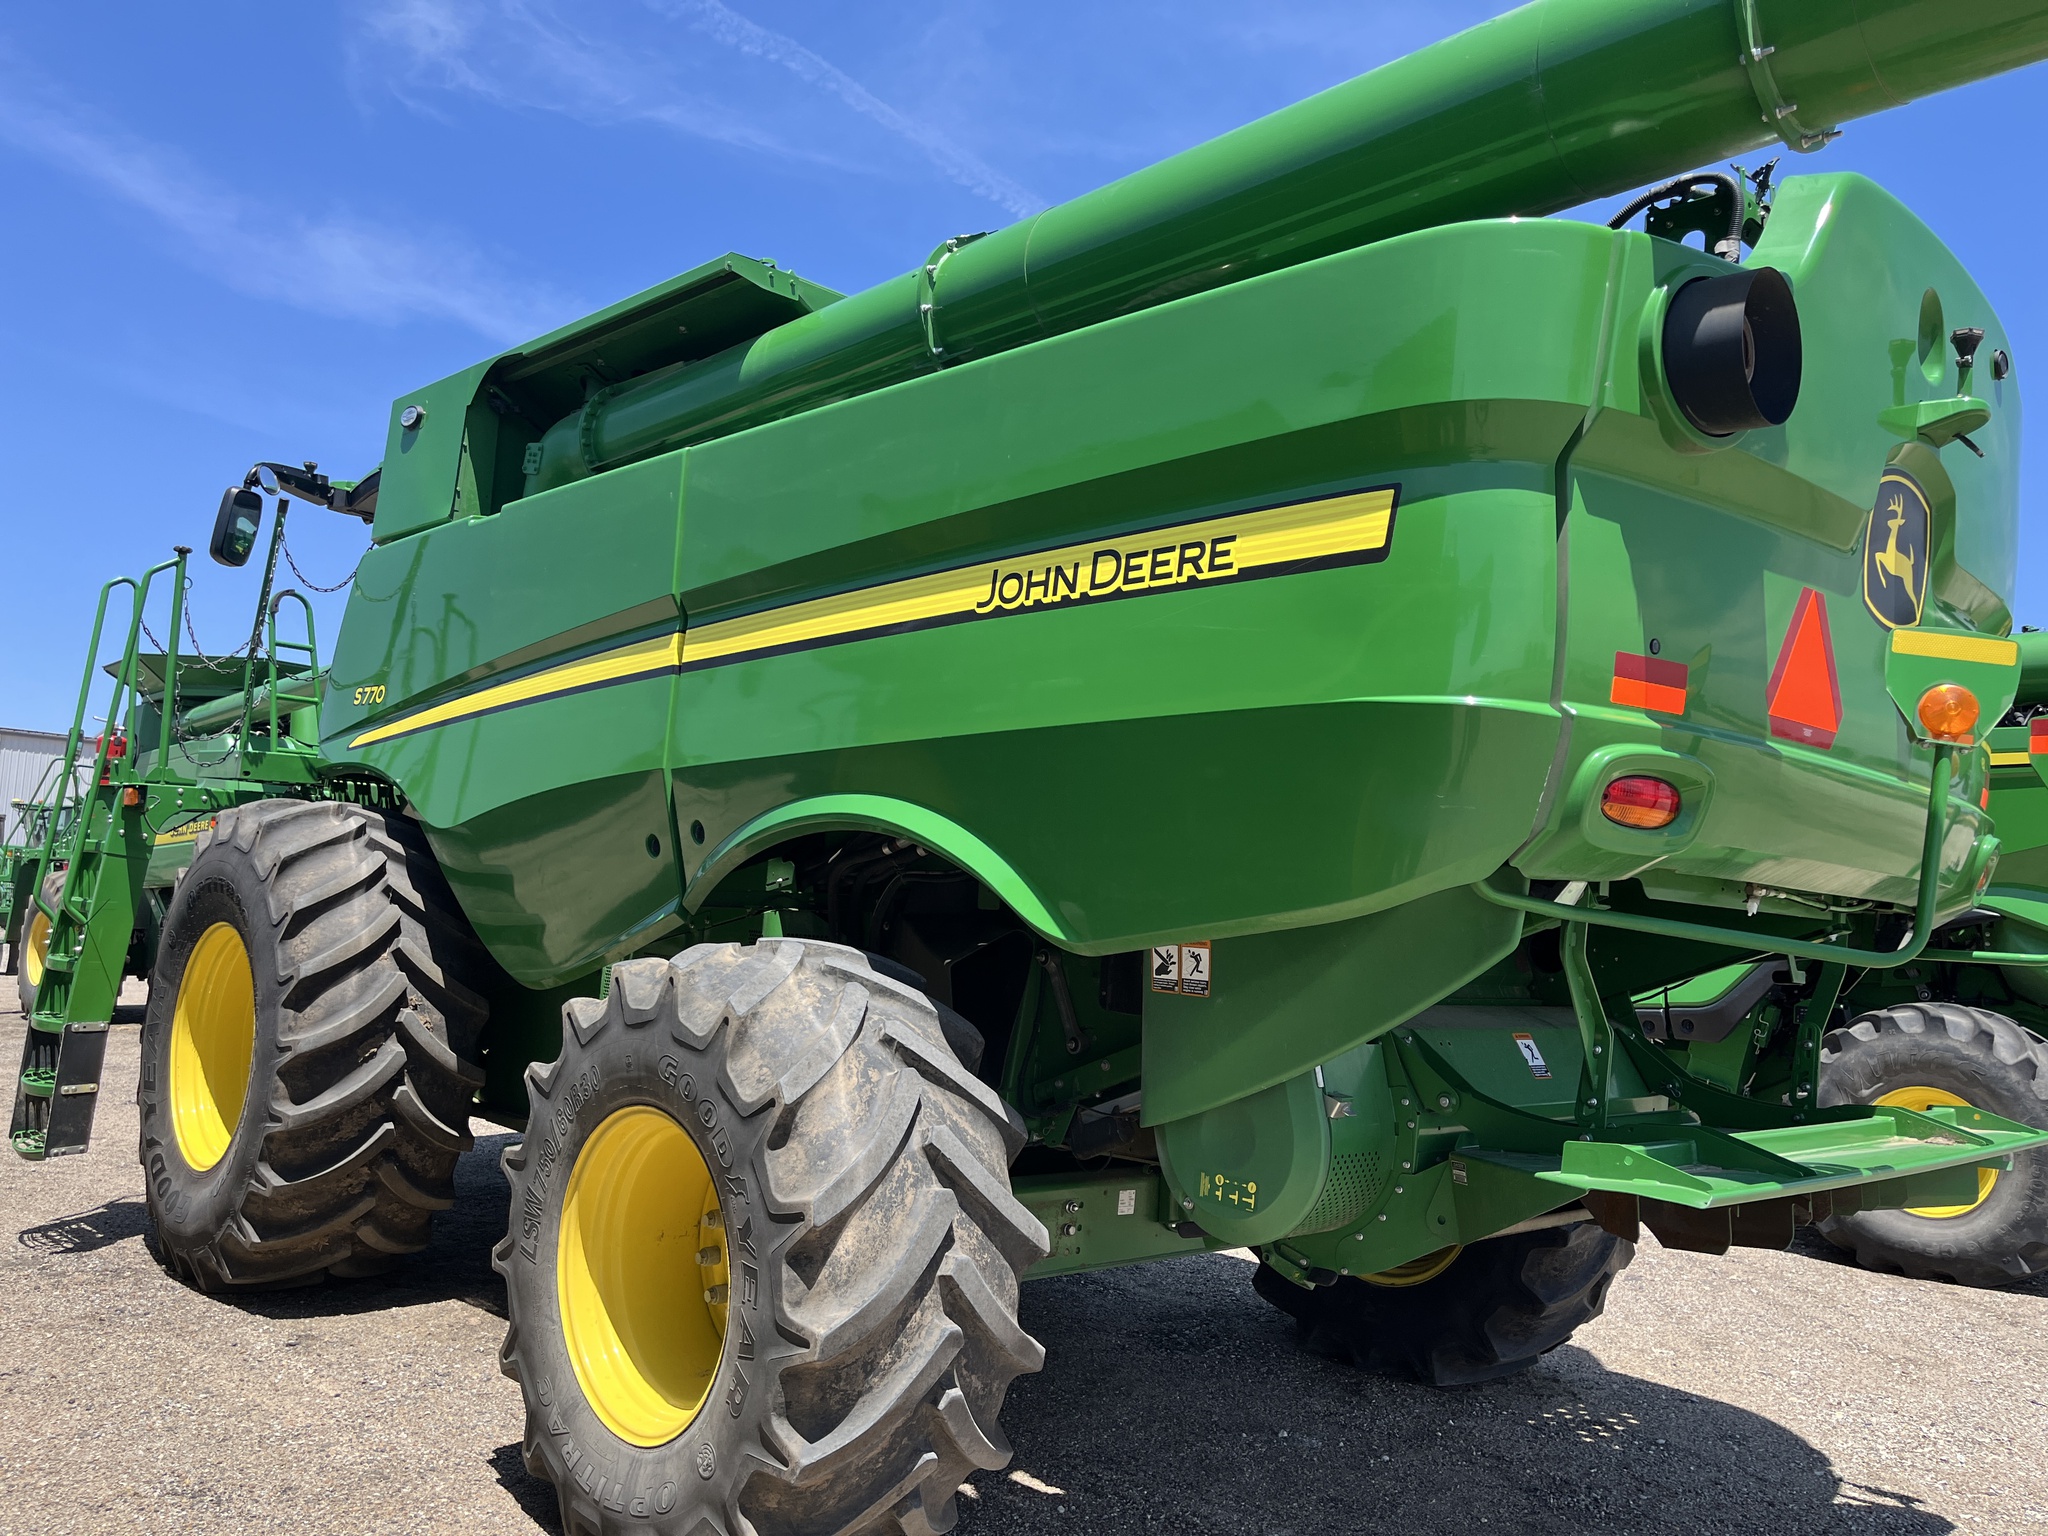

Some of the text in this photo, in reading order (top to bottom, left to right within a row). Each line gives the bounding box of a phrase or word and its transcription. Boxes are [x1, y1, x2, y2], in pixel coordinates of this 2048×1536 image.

[976, 535, 1238, 611] JOHN DEERE
[353, 684, 386, 705] S770
[188, 820, 209, 834] DEERE
[143, 976, 192, 1224] GOODYEAR
[520, 1185, 543, 1264] LSW
[536, 1375, 677, 1517] OPTITRAC
